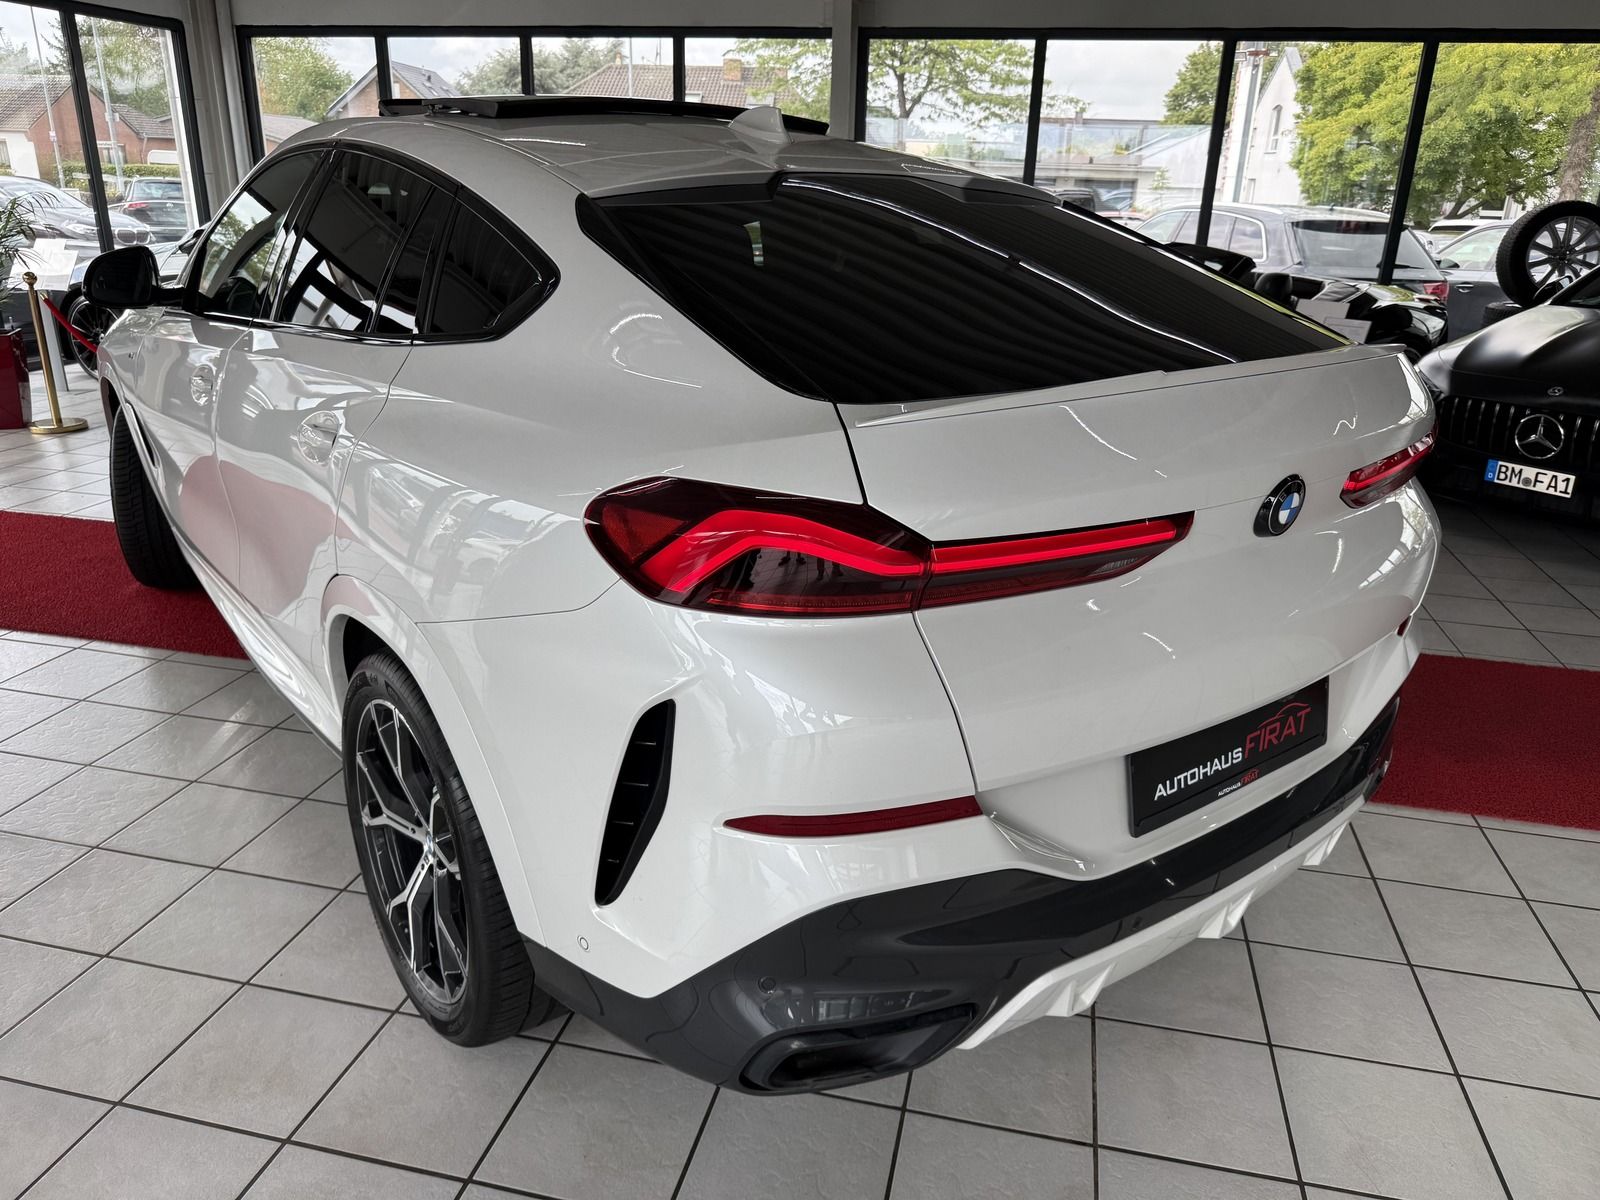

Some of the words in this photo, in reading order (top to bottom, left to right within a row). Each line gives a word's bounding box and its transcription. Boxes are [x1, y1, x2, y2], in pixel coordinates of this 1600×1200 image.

[1496, 464, 1523, 485] BM
[1533, 472, 1571, 495] FA1
[1154, 747, 1243, 801] AUTOHAUS
[1244, 706, 1312, 759] FIRAT
